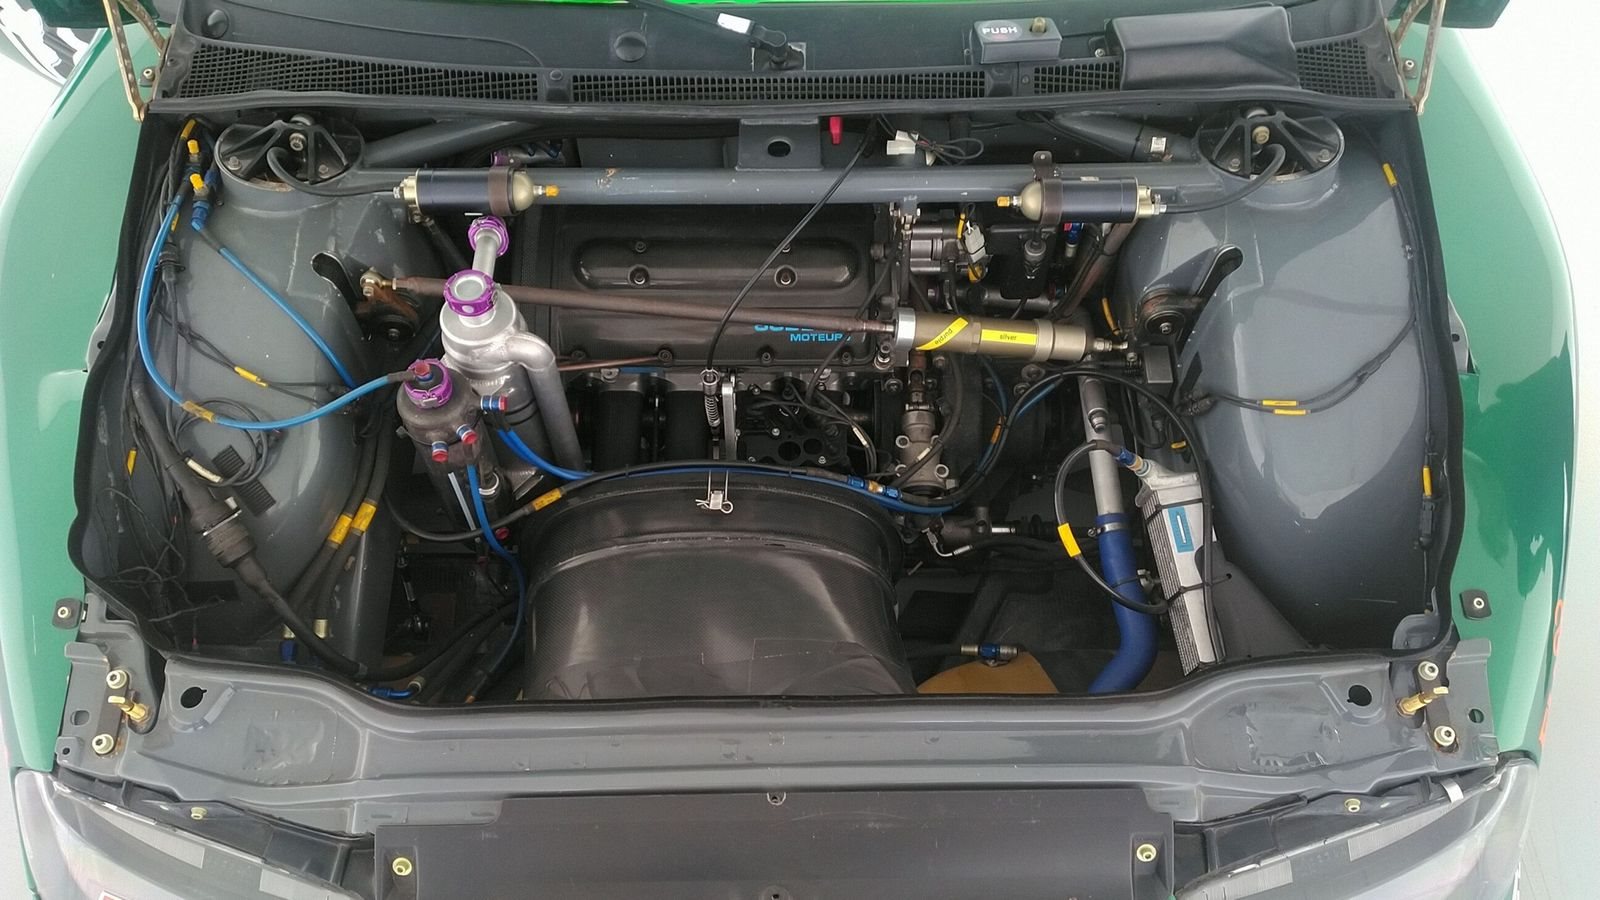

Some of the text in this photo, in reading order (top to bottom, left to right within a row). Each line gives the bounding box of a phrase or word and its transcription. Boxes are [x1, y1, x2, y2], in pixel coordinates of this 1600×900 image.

[982, 26, 1018, 35] PUSH
[935, 328, 953, 345] purple
[999, 333, 1017, 341] silver
